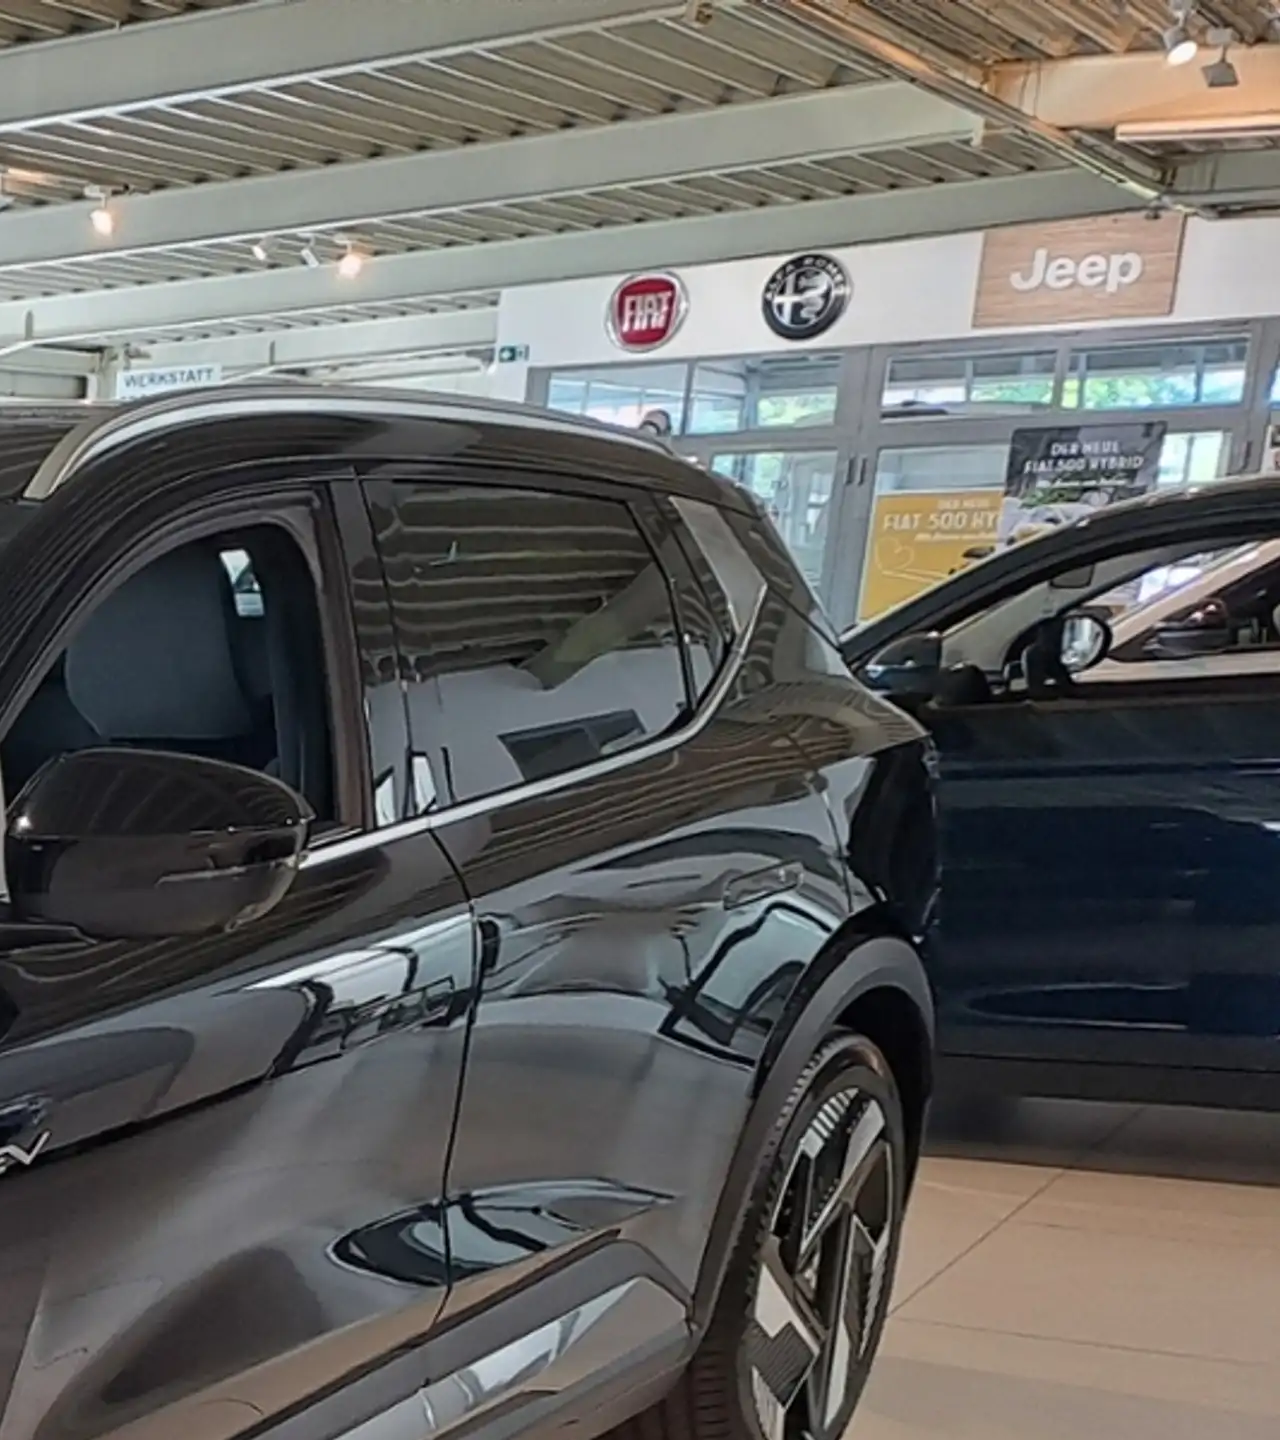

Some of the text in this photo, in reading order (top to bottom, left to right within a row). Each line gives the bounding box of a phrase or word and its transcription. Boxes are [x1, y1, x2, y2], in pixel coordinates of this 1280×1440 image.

[1010, 247, 1142, 293] Jeep
[622, 290, 672, 333] FIAT
[1056, 458, 1086, 472] 500
[883, 513, 922, 531] FIAT
[926, 511, 968, 530] 500
